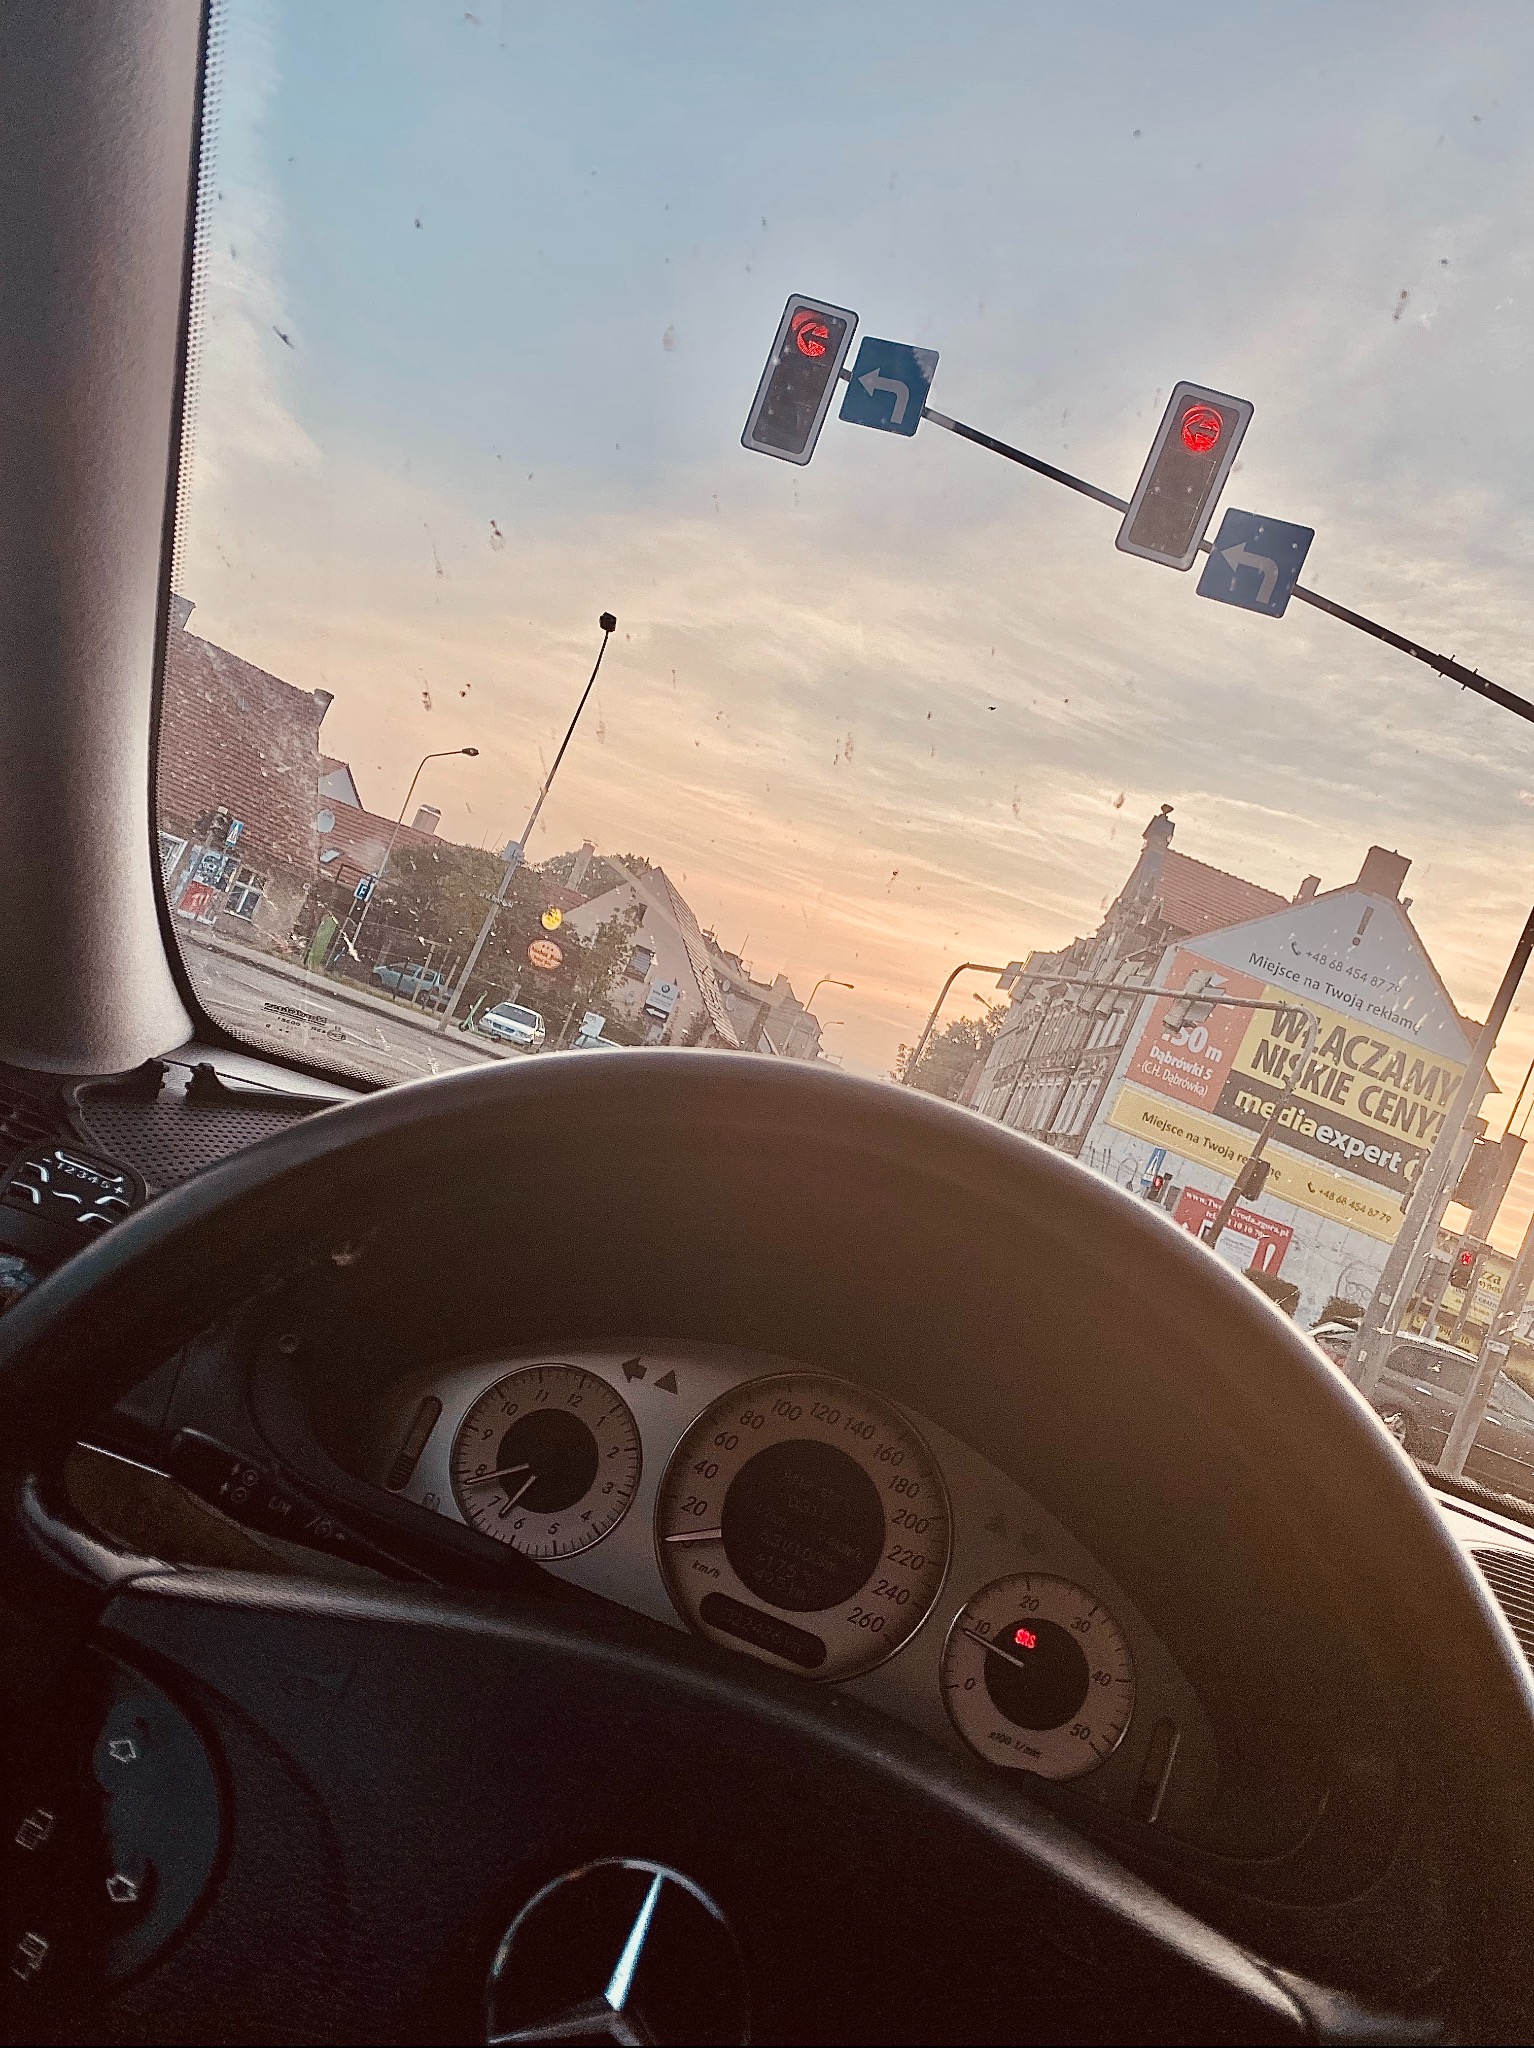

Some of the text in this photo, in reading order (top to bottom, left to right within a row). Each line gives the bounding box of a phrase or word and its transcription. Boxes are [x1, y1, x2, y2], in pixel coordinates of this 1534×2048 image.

[1306, 950, 1326, 965] +48
[1329, 959, 1343, 972] 68
[1346, 966, 1368, 982] 454
[1371, 976, 1385, 988] 87
[1248, 952, 1422, 1035] Miejsce na Twoją reklamę
[1150, 1046, 1204, 1078] Dąbrówki
[1205, 1046, 1223, 1063] m
[1162, 1070, 1208, 1097] Dąbrówka)
[1251, 1039, 1447, 1144] NISKIE CENY!
[1142, 1111, 1183, 1137] Miejsce
[1186, 1132, 1199, 1144] na
[1202, 1137, 1234, 1161] Twoją
[1234, 1090, 1402, 1174] mediaexpert
[64, 1166, 74, 1174] 2
[77, 1170, 87, 1178] 3
[1319, 1187, 1392, 1224] +48 68 454 87 79
[535, 1389, 550, 1403] 11
[569, 1393, 583, 1408] 12
[501, 1401, 518, 1416] 10
[771, 1399, 802, 1421] 100
[810, 1402, 840, 1425] 120
[596, 1416, 606, 1427] 1
[740, 1410, 765, 1430] 80
[844, 1417, 876, 1440] 140
[482, 1428, 494, 1441] 9
[714, 1432, 738, 1451] 60
[607, 1446, 619, 1459] 2
[873, 1444, 905, 1467] 160
[475, 1464, 487, 1476] 8
[694, 1460, 719, 1479] 40
[602, 1482, 614, 1494] 3
[888, 1474, 920, 1499] 180
[488, 1496, 501, 1508] 7
[681, 1496, 708, 1516] 20
[514, 1517, 526, 1530] 6
[580, 1510, 592, 1522] 4
[892, 1508, 929, 1534] 200
[548, 1522, 560, 1535] 5
[887, 1544, 925, 1570] 220
[692, 1560, 721, 1580] km/h
[872, 1579, 911, 1606] 240
[1019, 1595, 1040, 1612] 20
[847, 1606, 886, 1633] 260
[974, 1620, 991, 1634] 10
[1070, 1616, 1091, 1632] 30
[964, 1678, 976, 1690] 0
[1092, 1670, 1112, 1686] 40
[1070, 1724, 1091, 1740] 50
